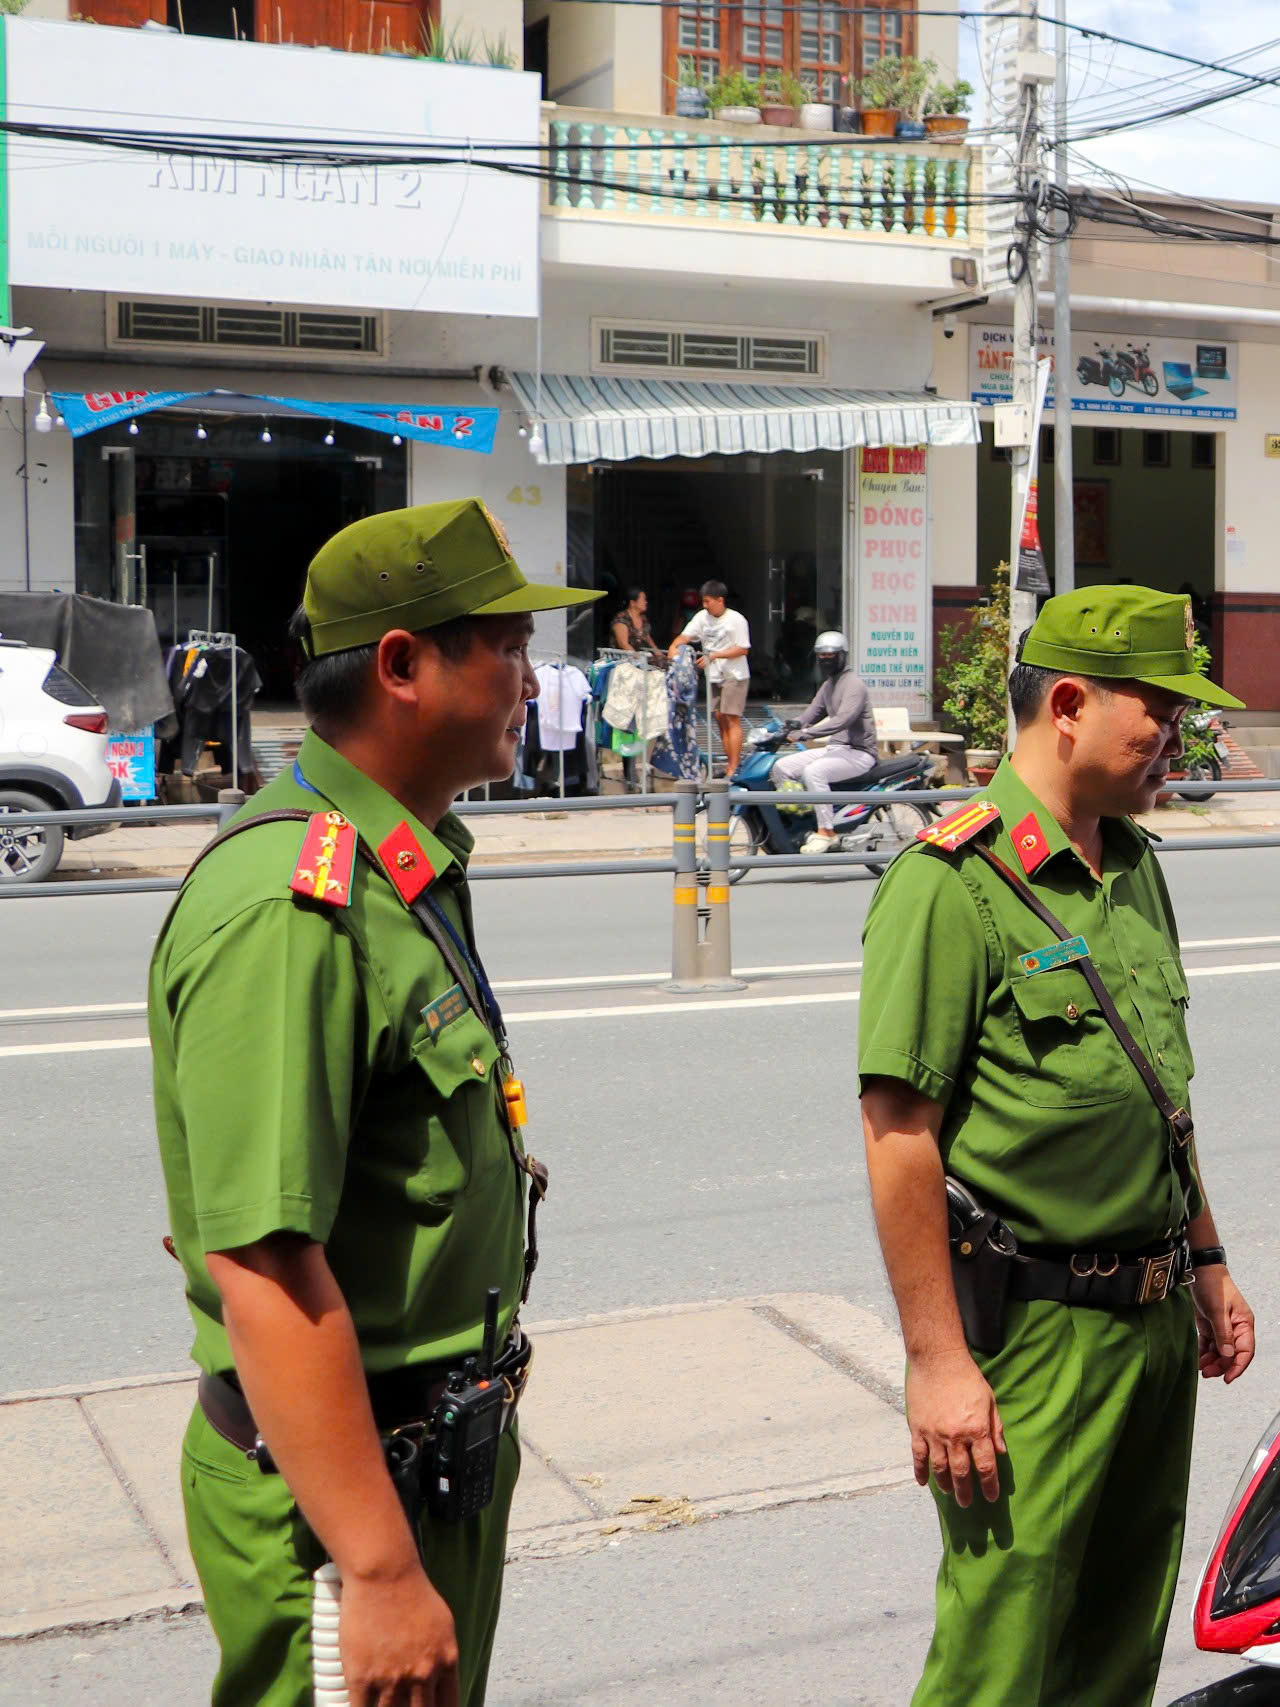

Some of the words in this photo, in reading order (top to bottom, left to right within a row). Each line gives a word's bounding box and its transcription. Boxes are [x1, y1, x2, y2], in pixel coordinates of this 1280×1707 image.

[233, 245, 284, 266] GIAO
[863, 499, 923, 527] ĐỒNG
[864, 540, 921, 563] PHỤC
[871, 571, 915, 595] HỌC
[868, 604, 917, 624] SINH
